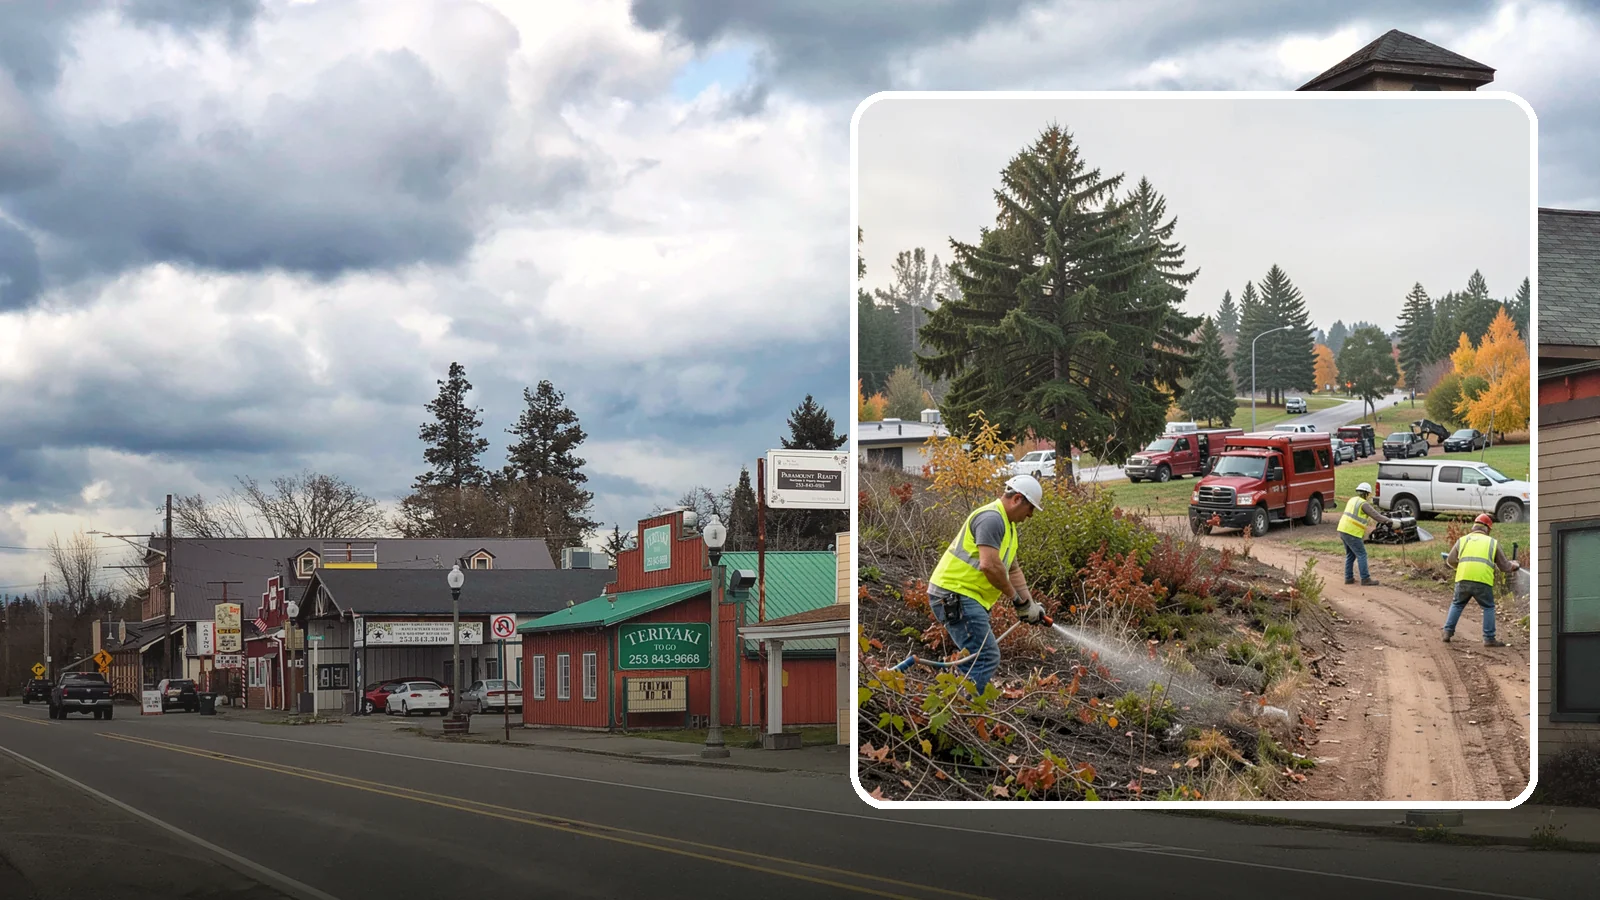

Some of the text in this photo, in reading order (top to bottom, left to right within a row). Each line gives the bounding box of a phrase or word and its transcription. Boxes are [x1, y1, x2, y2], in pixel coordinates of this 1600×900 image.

[624, 628, 702, 646] TERIYAKI
[629, 654, 700, 664] 253 843-9668
